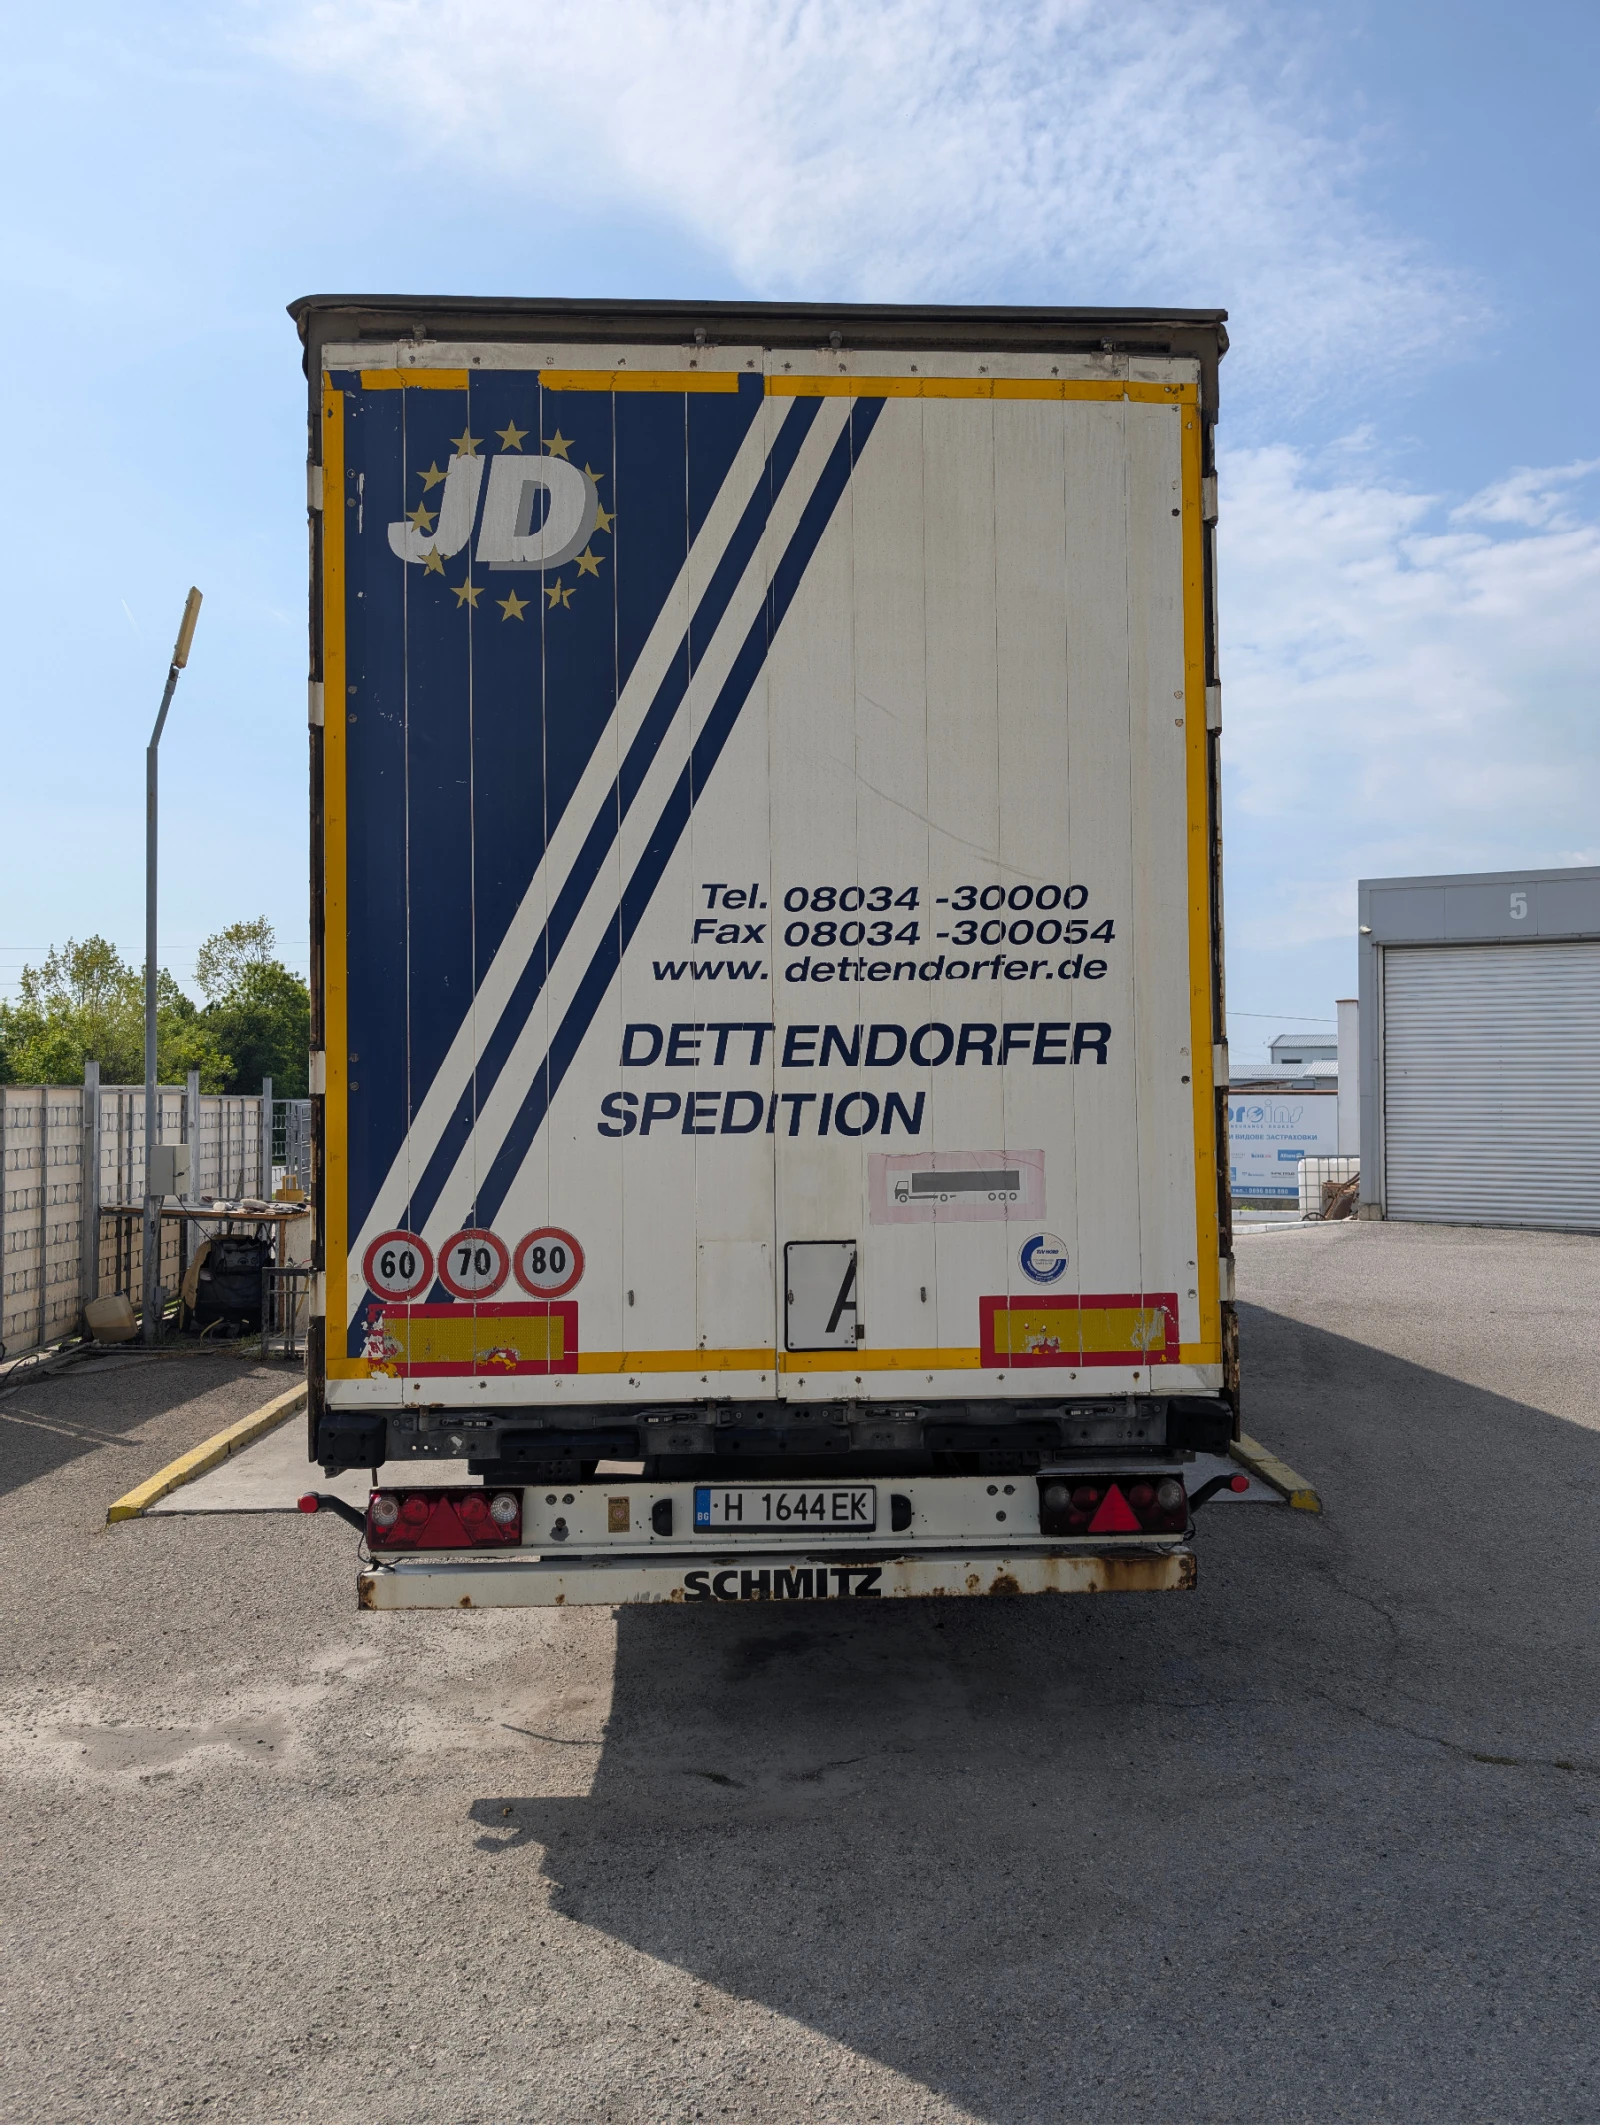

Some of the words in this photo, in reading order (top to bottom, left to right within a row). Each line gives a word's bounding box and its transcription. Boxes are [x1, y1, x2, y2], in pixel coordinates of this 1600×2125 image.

[387, 454, 599, 571] JD
[702, 883, 768, 910] Tel.
[784, 886, 920, 912] 08034
[936, 885, 1089, 911] -30000
[1509, 892, 1528, 920] 5
[690, 918, 767, 945] Fax
[784, 921, 921, 947] 08034
[936, 919, 1116, 946] -300054
[652, 960, 769, 981] www.
[785, 953, 1108, 983] dettendorfer.de
[619, 1021, 1112, 1068] DETTENDORFER
[597, 1091, 926, 1138] SPEDITION
[380, 1250, 416, 1279] 60
[457, 1247, 491, 1276] 70
[532, 1246, 566, 1274] 80
[697, 1512, 710, 1521] BG
[724, 1493, 744, 1521] H
[683, 1567, 883, 1602] SCHMITZ
